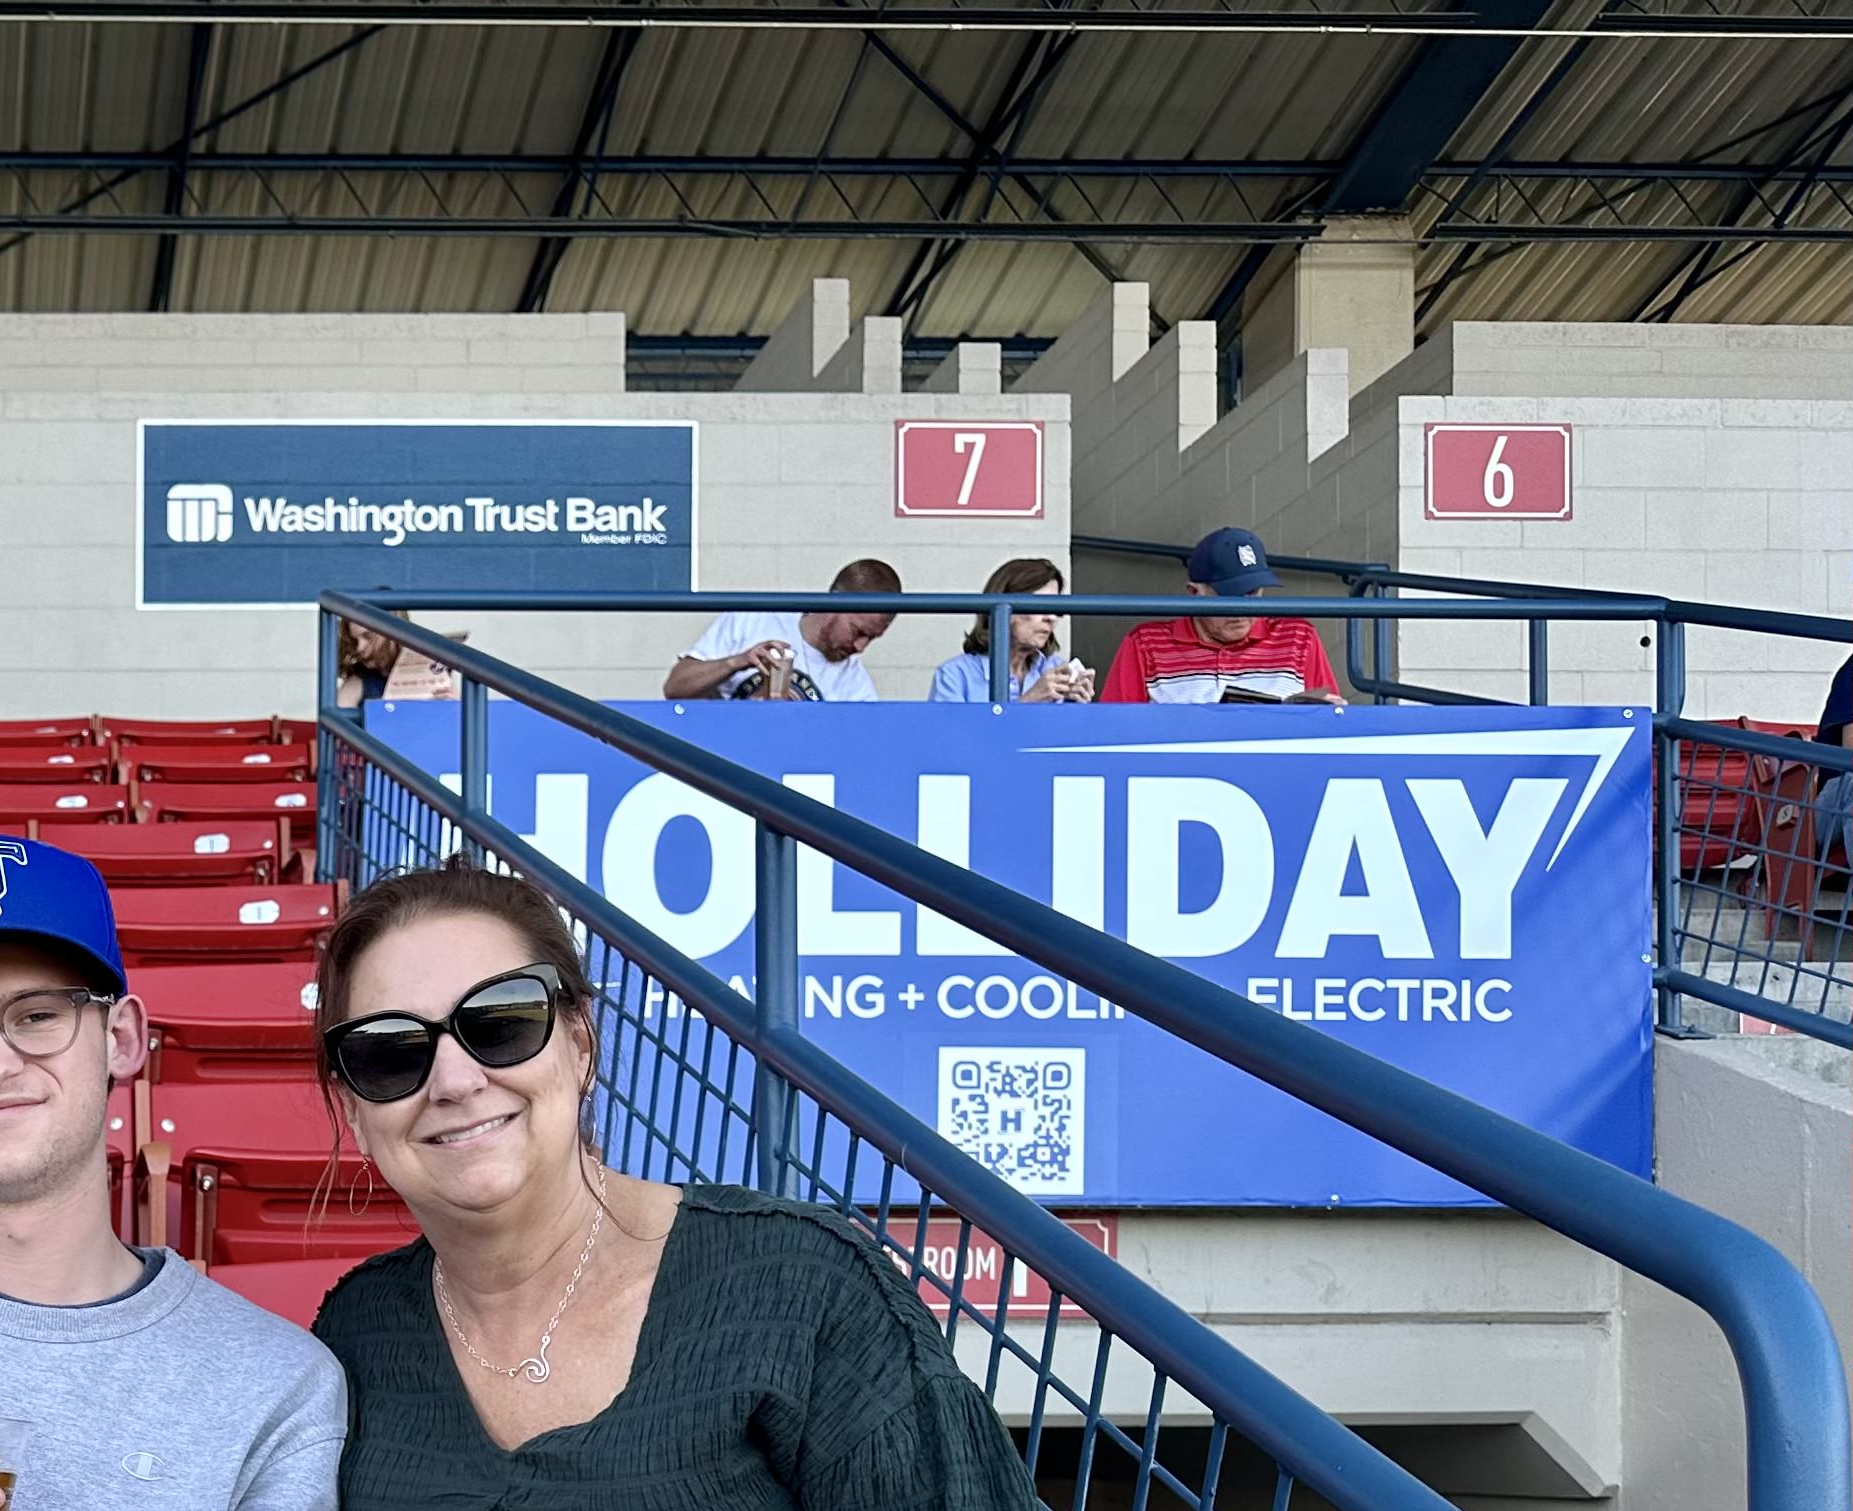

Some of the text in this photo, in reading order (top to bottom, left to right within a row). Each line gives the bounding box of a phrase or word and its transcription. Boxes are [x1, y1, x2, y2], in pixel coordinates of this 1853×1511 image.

[953, 432, 987, 506] 7
[1483, 435, 1514, 508] 6
[243, 496, 668, 547] Washington Trust Bank
[1247, 977, 1514, 1023] ELECTRIC
